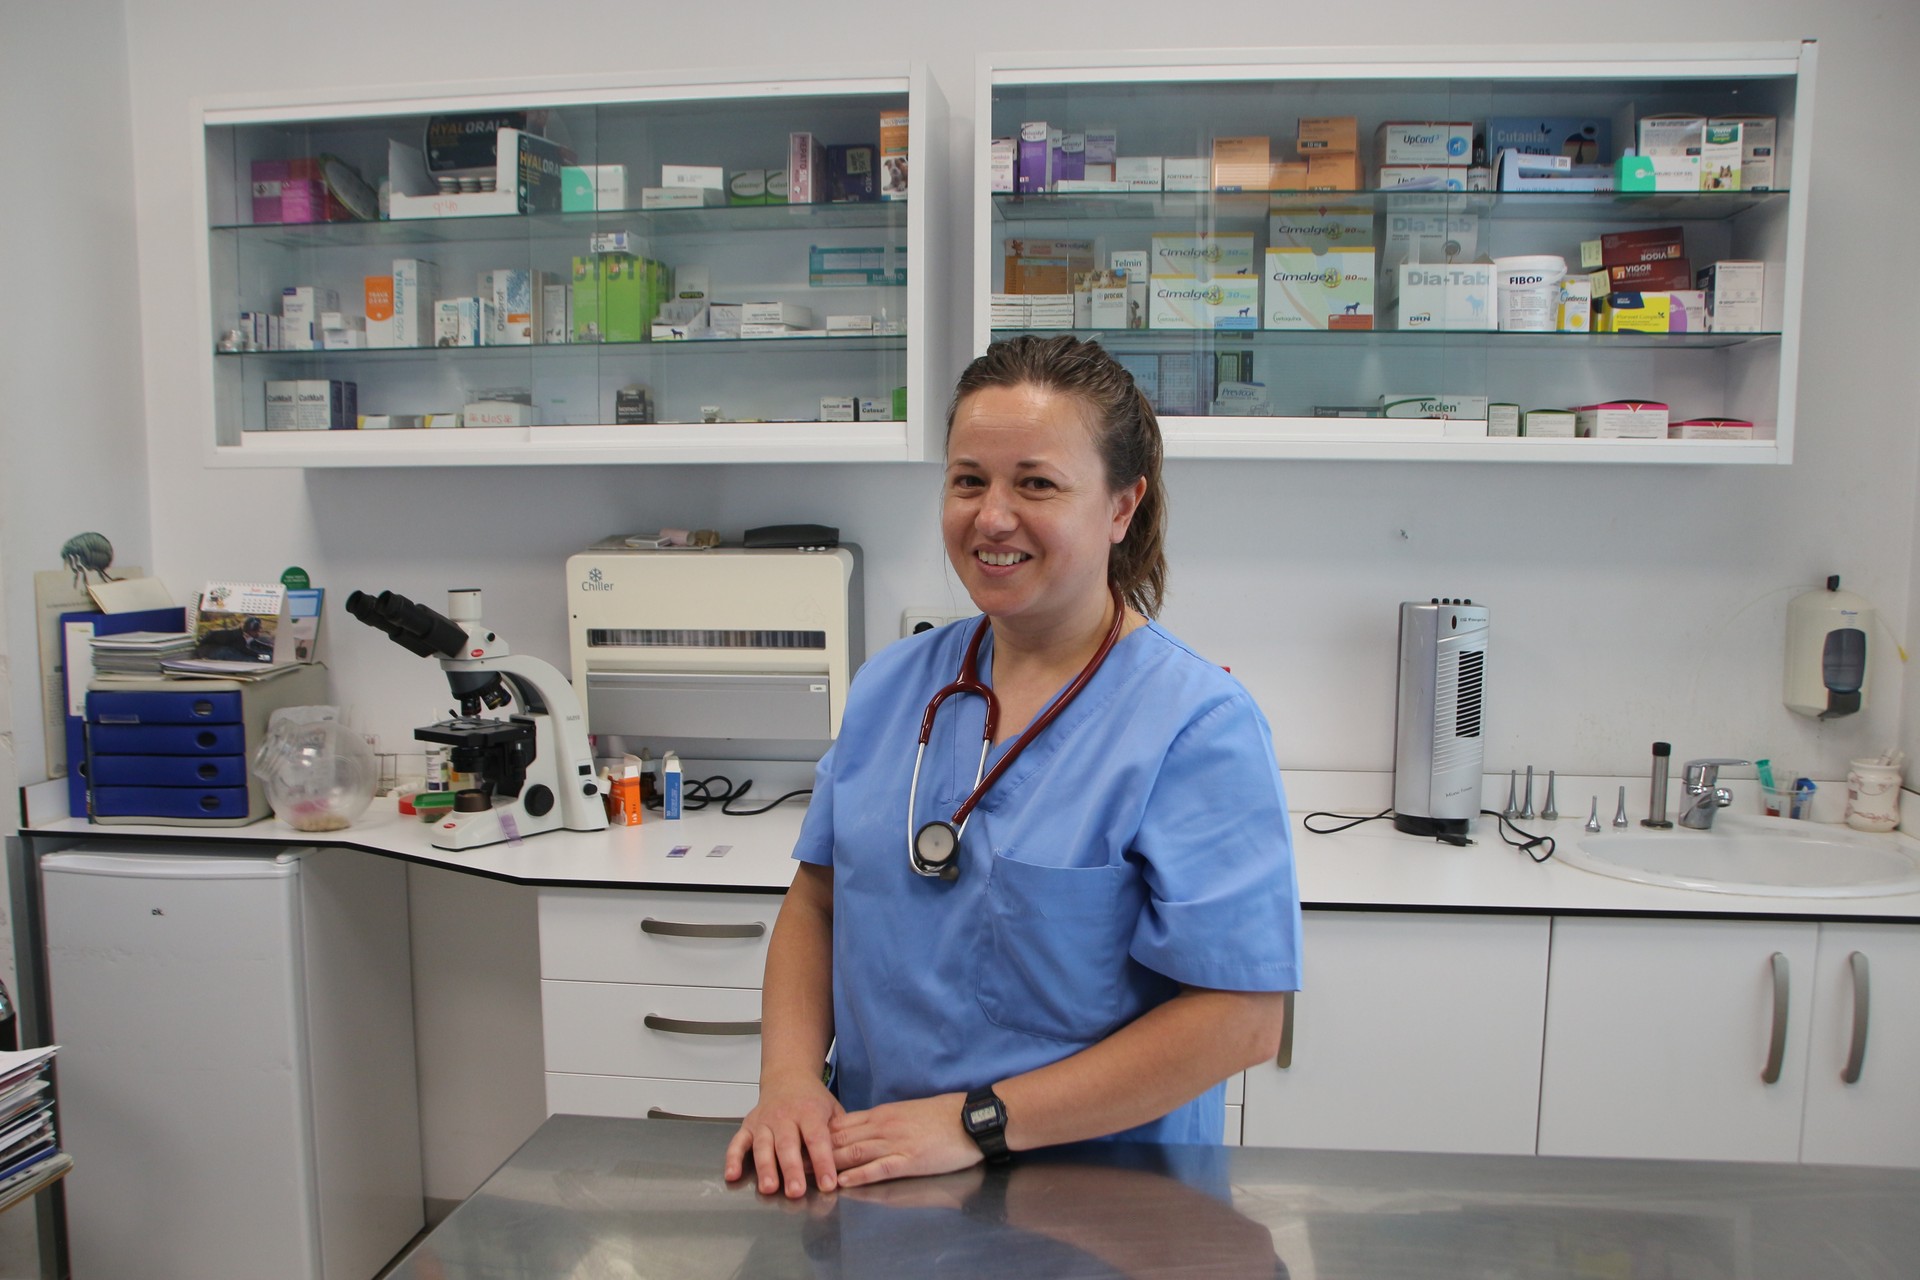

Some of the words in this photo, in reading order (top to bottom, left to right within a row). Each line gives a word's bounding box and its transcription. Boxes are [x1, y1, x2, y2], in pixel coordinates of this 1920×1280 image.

[519, 150, 562, 177] HYALORA
[1279, 225, 1338, 235] Cimalgex
[1159, 248, 1217, 258] Cimalgex
[1114, 259, 1142, 267] Telmin
[1625, 264, 1652, 273] VIGOR
[1273, 272, 1335, 283] Cimalgex
[1103, 292, 1124, 300] procox
[1157, 289, 1218, 300] Cimalgex
[1420, 402, 1457, 412] Xeden
[581, 581, 615, 592] Chiller
